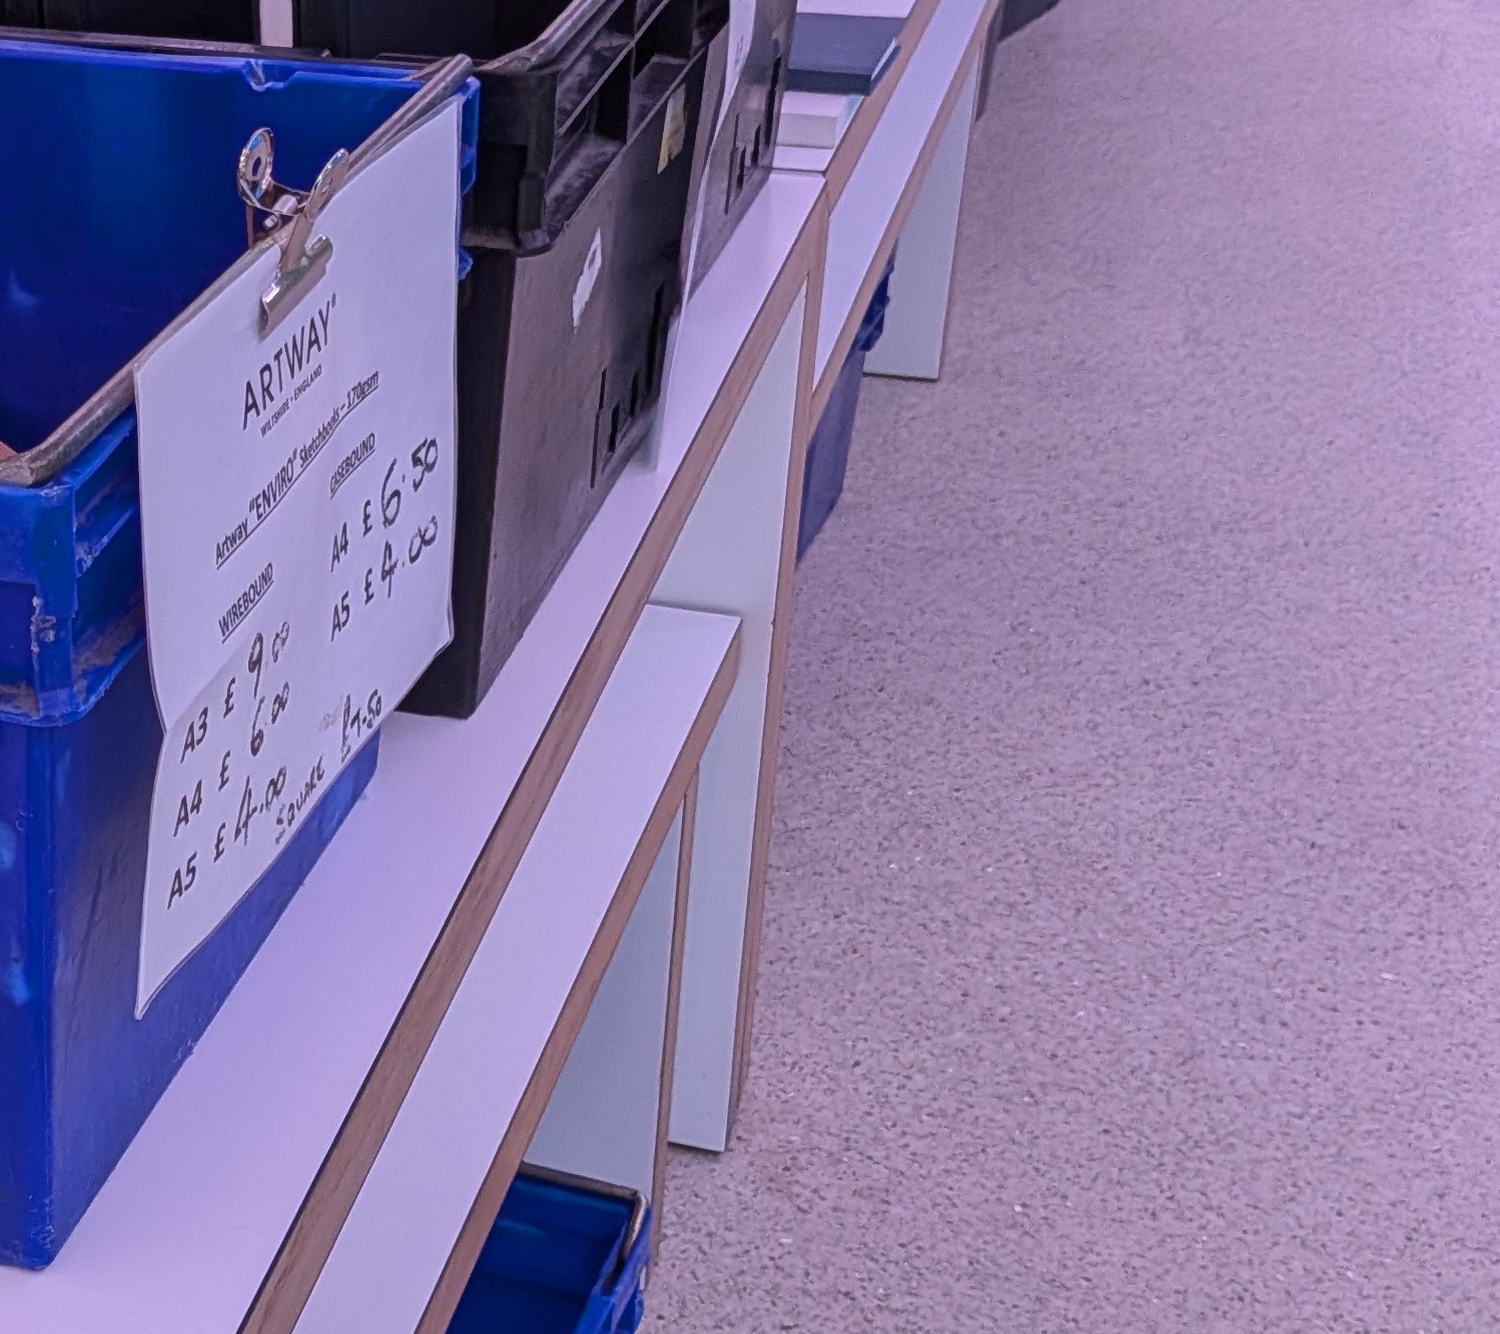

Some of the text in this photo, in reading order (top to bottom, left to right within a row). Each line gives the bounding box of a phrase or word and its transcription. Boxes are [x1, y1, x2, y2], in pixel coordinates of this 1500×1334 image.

[242, 299, 331, 431] ARTWAY
[293, 363, 323, 401] ENGLAND
[216, 517, 249, 566] Artway
[299, 406, 341, 468] Sketchbooks
[346, 370, 380, 410] 170gsm
[330, 432, 376, 494] CASEBOUND
[330, 521, 349, 573] A4
[218, 562, 274, 639] WIREBOUND
[330, 590, 351, 642] A5
[180, 706, 209, 764] A3
[173, 778, 203, 838] A4
[166, 851, 198, 911] A5
